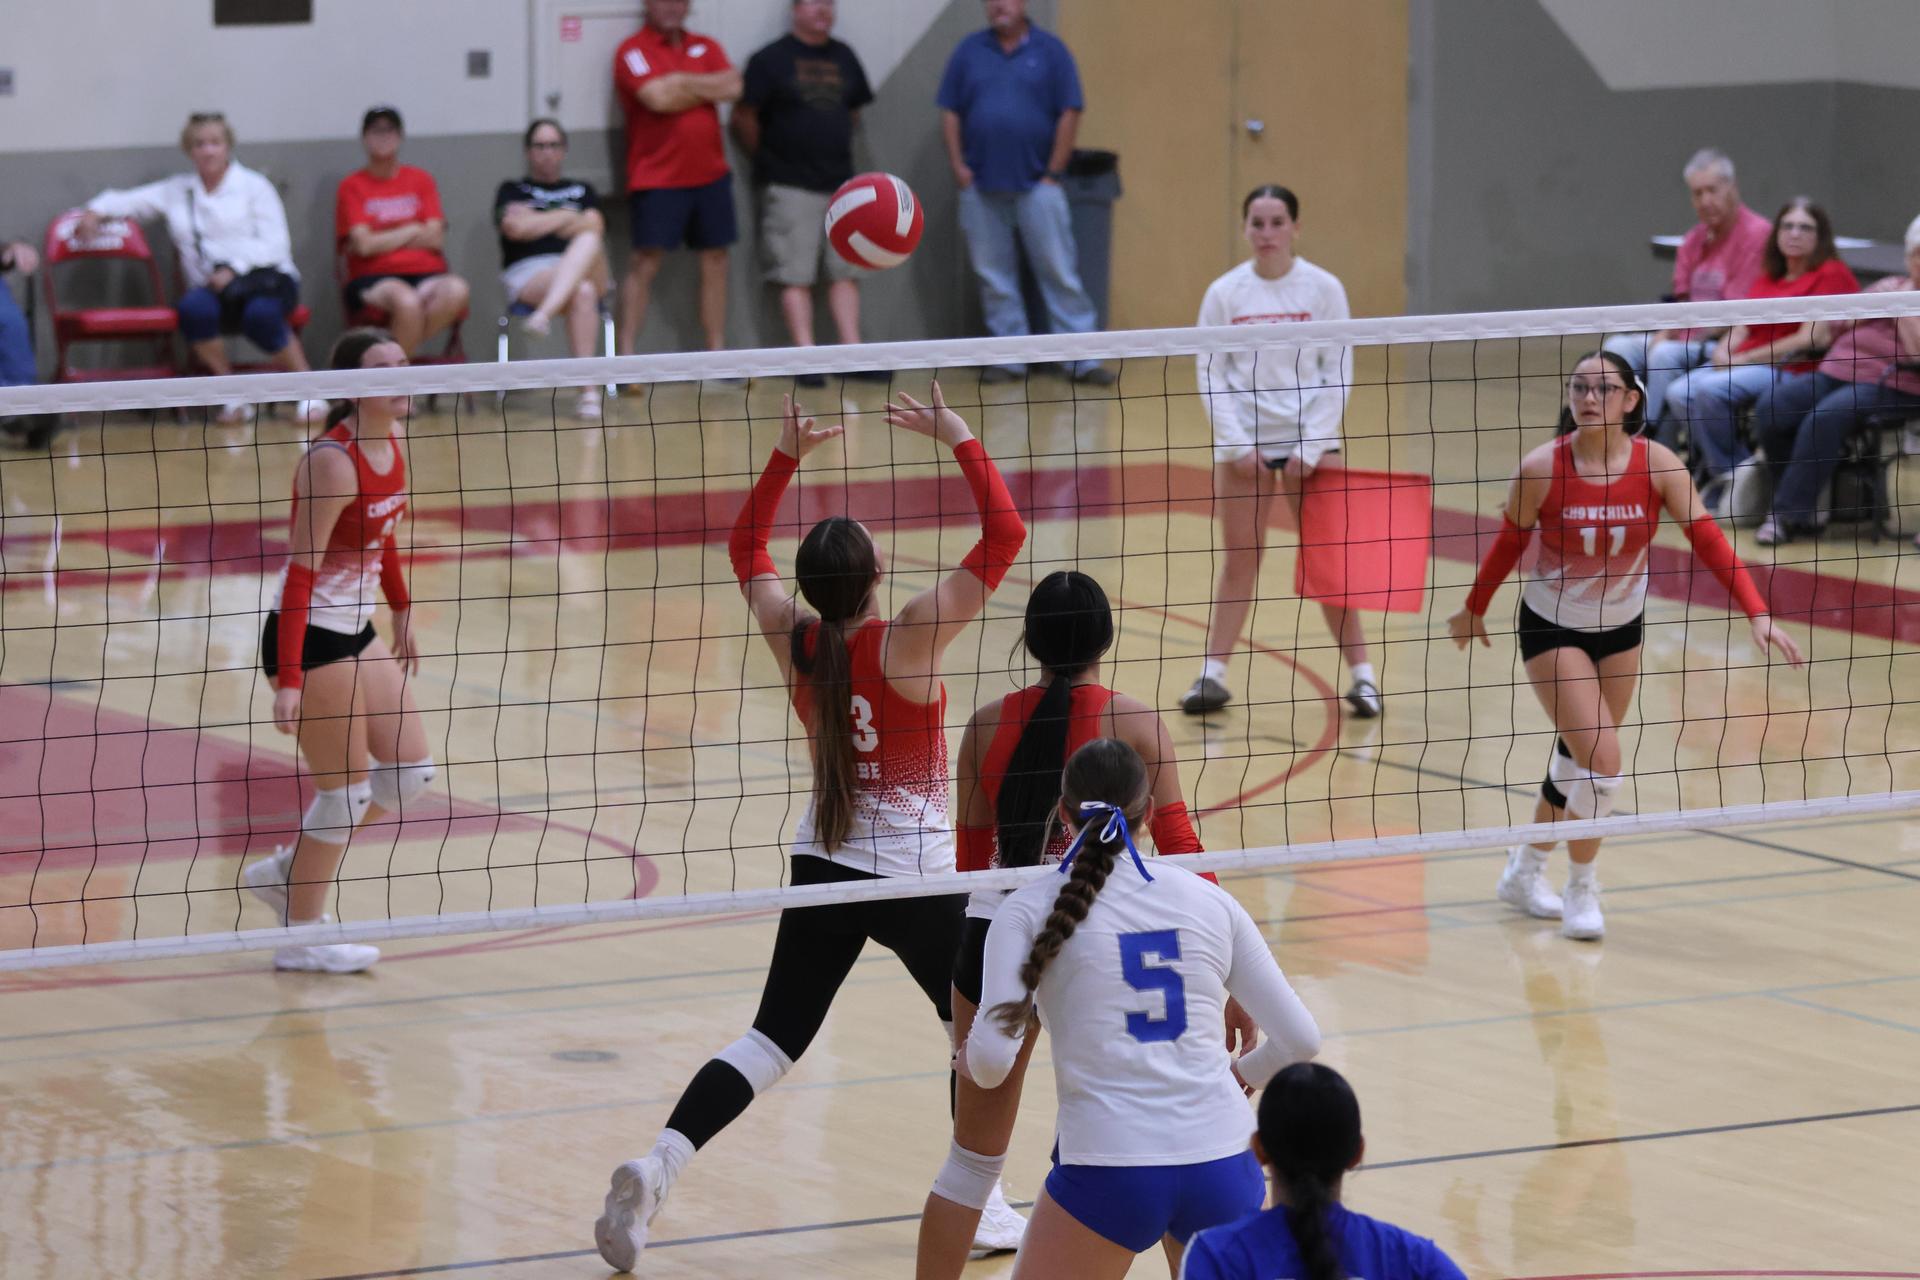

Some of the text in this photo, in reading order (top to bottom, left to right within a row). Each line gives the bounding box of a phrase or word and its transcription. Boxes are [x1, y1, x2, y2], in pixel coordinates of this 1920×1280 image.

[1562, 504, 1645, 520] CHOWCHILLA
[1579, 525, 1626, 557] 11
[857, 762, 881, 780] BE
[1117, 928, 1188, 1043] 5
